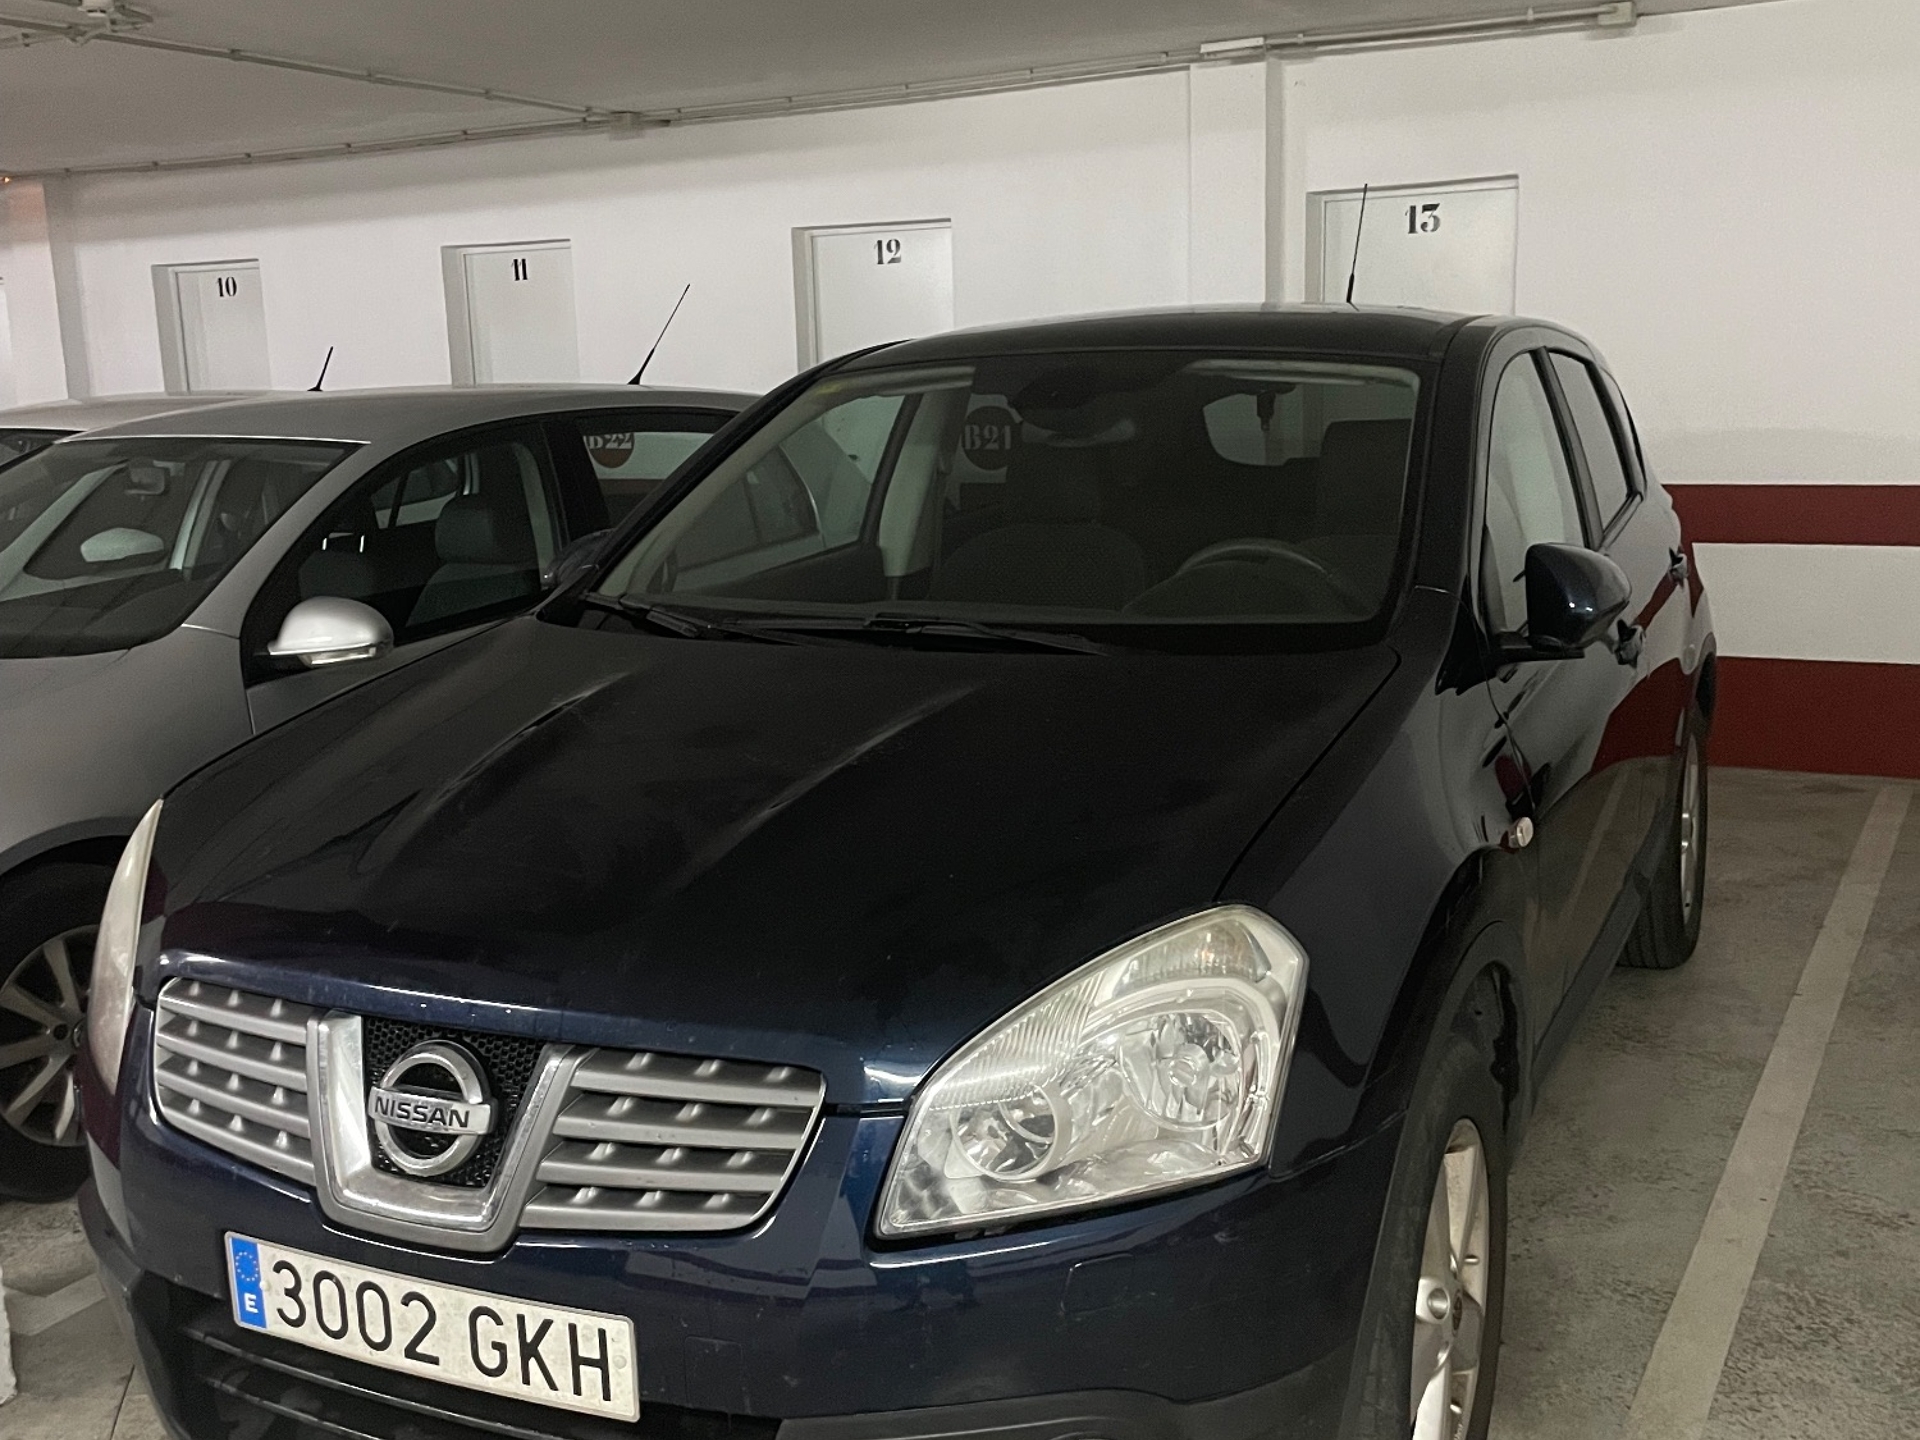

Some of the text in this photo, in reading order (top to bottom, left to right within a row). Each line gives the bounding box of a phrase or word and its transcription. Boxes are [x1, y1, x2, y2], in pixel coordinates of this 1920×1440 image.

[1405, 202, 1441, 235] 13
[874, 238, 902, 265] 12
[511, 258, 528, 281] 11
[216, 276, 238, 297] 10
[964, 425, 1012, 450] B21
[374, 1095, 470, 1129] NISSAN
[243, 1292, 259, 1314] E
[272, 1259, 612, 1402] 3002 GKH
